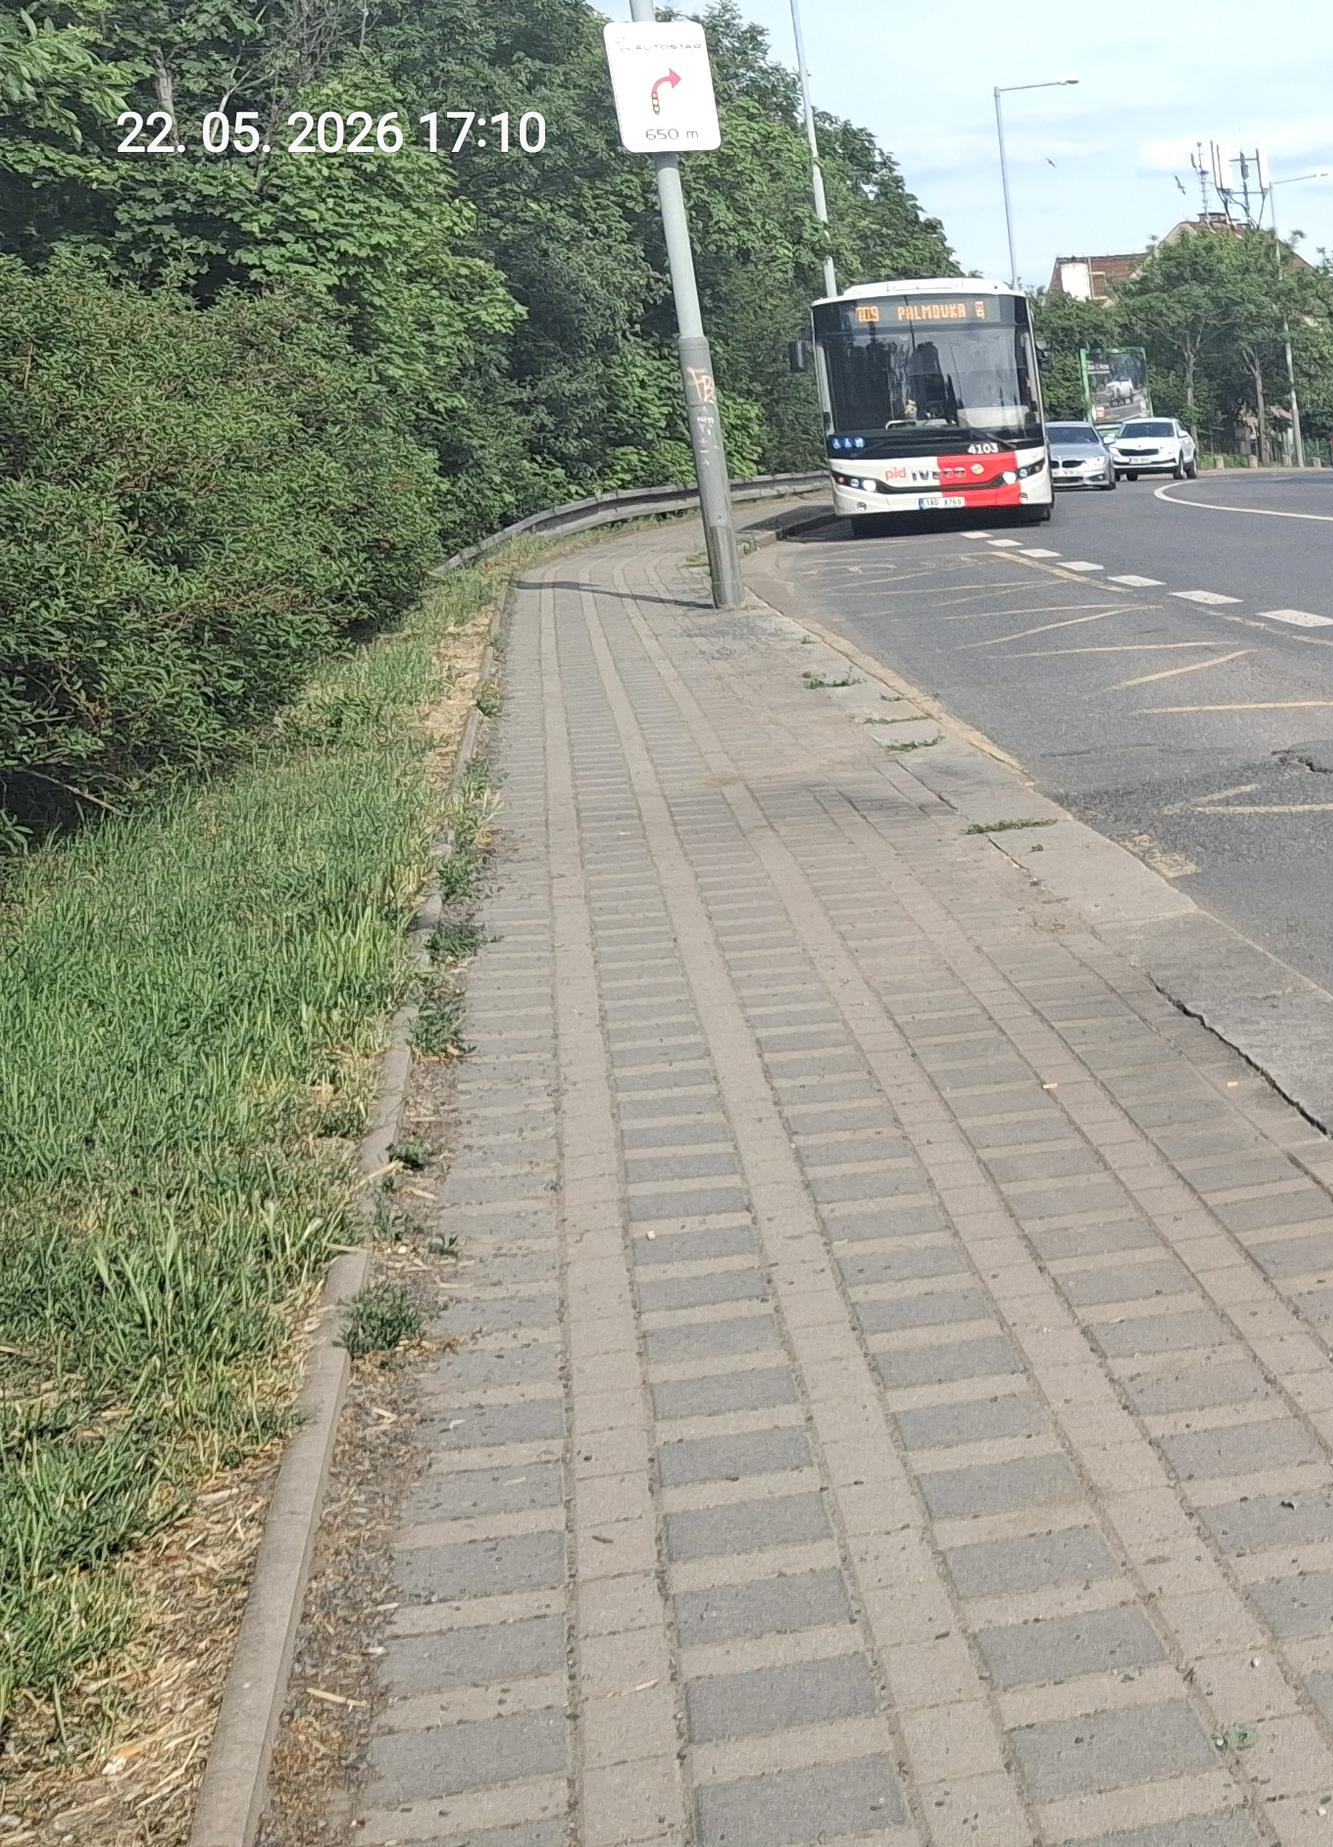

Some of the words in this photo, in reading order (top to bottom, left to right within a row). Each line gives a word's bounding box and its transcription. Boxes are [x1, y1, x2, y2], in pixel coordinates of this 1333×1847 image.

[645, 128, 679, 140] 650
[686, 130, 699, 139] m
[897, 303, 967, 320] PALMOVKA
[967, 442, 999, 454] 4103
[885, 467, 907, 481] pid
